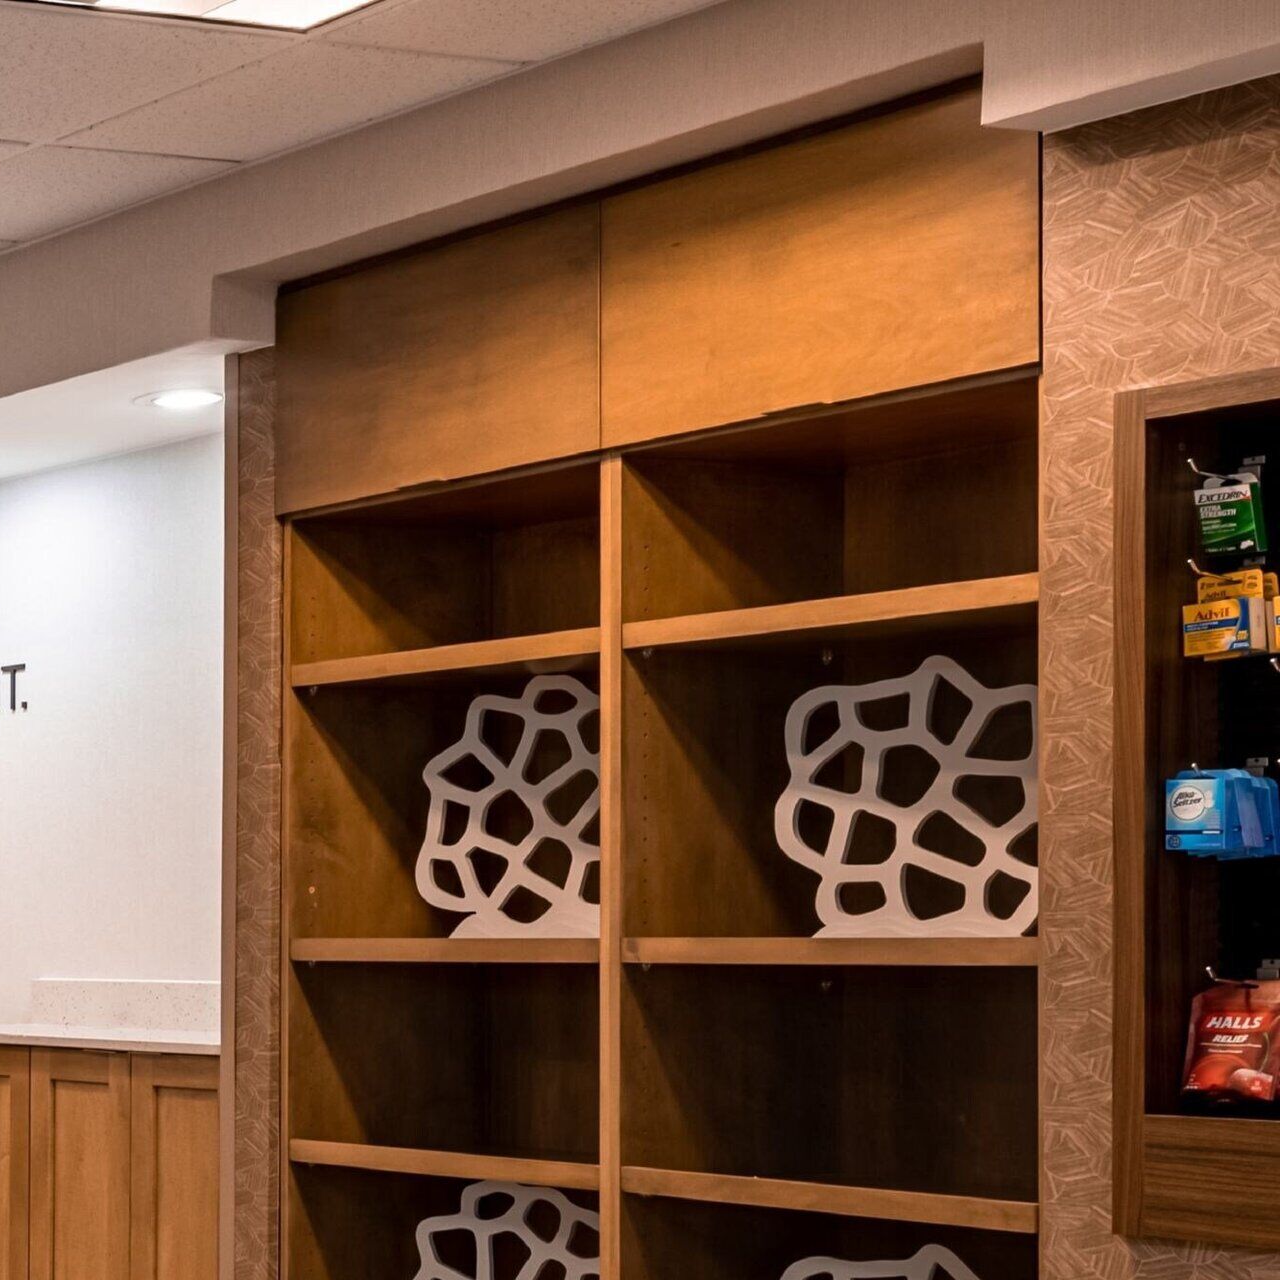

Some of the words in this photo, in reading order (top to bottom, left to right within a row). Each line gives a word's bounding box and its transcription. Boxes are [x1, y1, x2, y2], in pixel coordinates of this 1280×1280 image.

[1197, 490, 1249, 504] EXCEDRIN
[1194, 606, 1231, 622] Advil
[1206, 1016, 1264, 1029] HALLS
[1211, 1034, 1249, 1043] RELIEF
